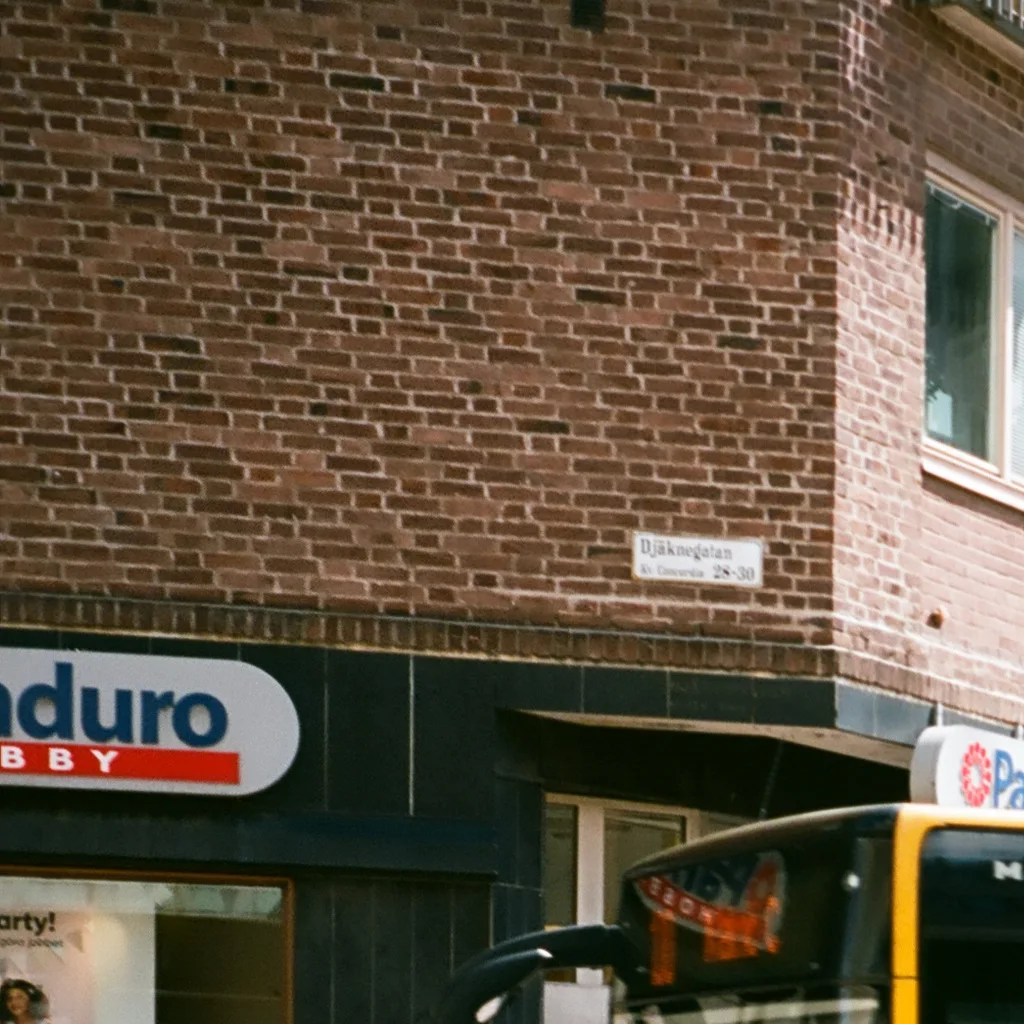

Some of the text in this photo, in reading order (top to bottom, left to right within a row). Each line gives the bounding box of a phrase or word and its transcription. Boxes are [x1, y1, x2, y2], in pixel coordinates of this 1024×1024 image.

[641, 538, 732, 561] Djäknegatan
[0, 662, 228, 748] duro
[0, 911, 56, 936] arty!
